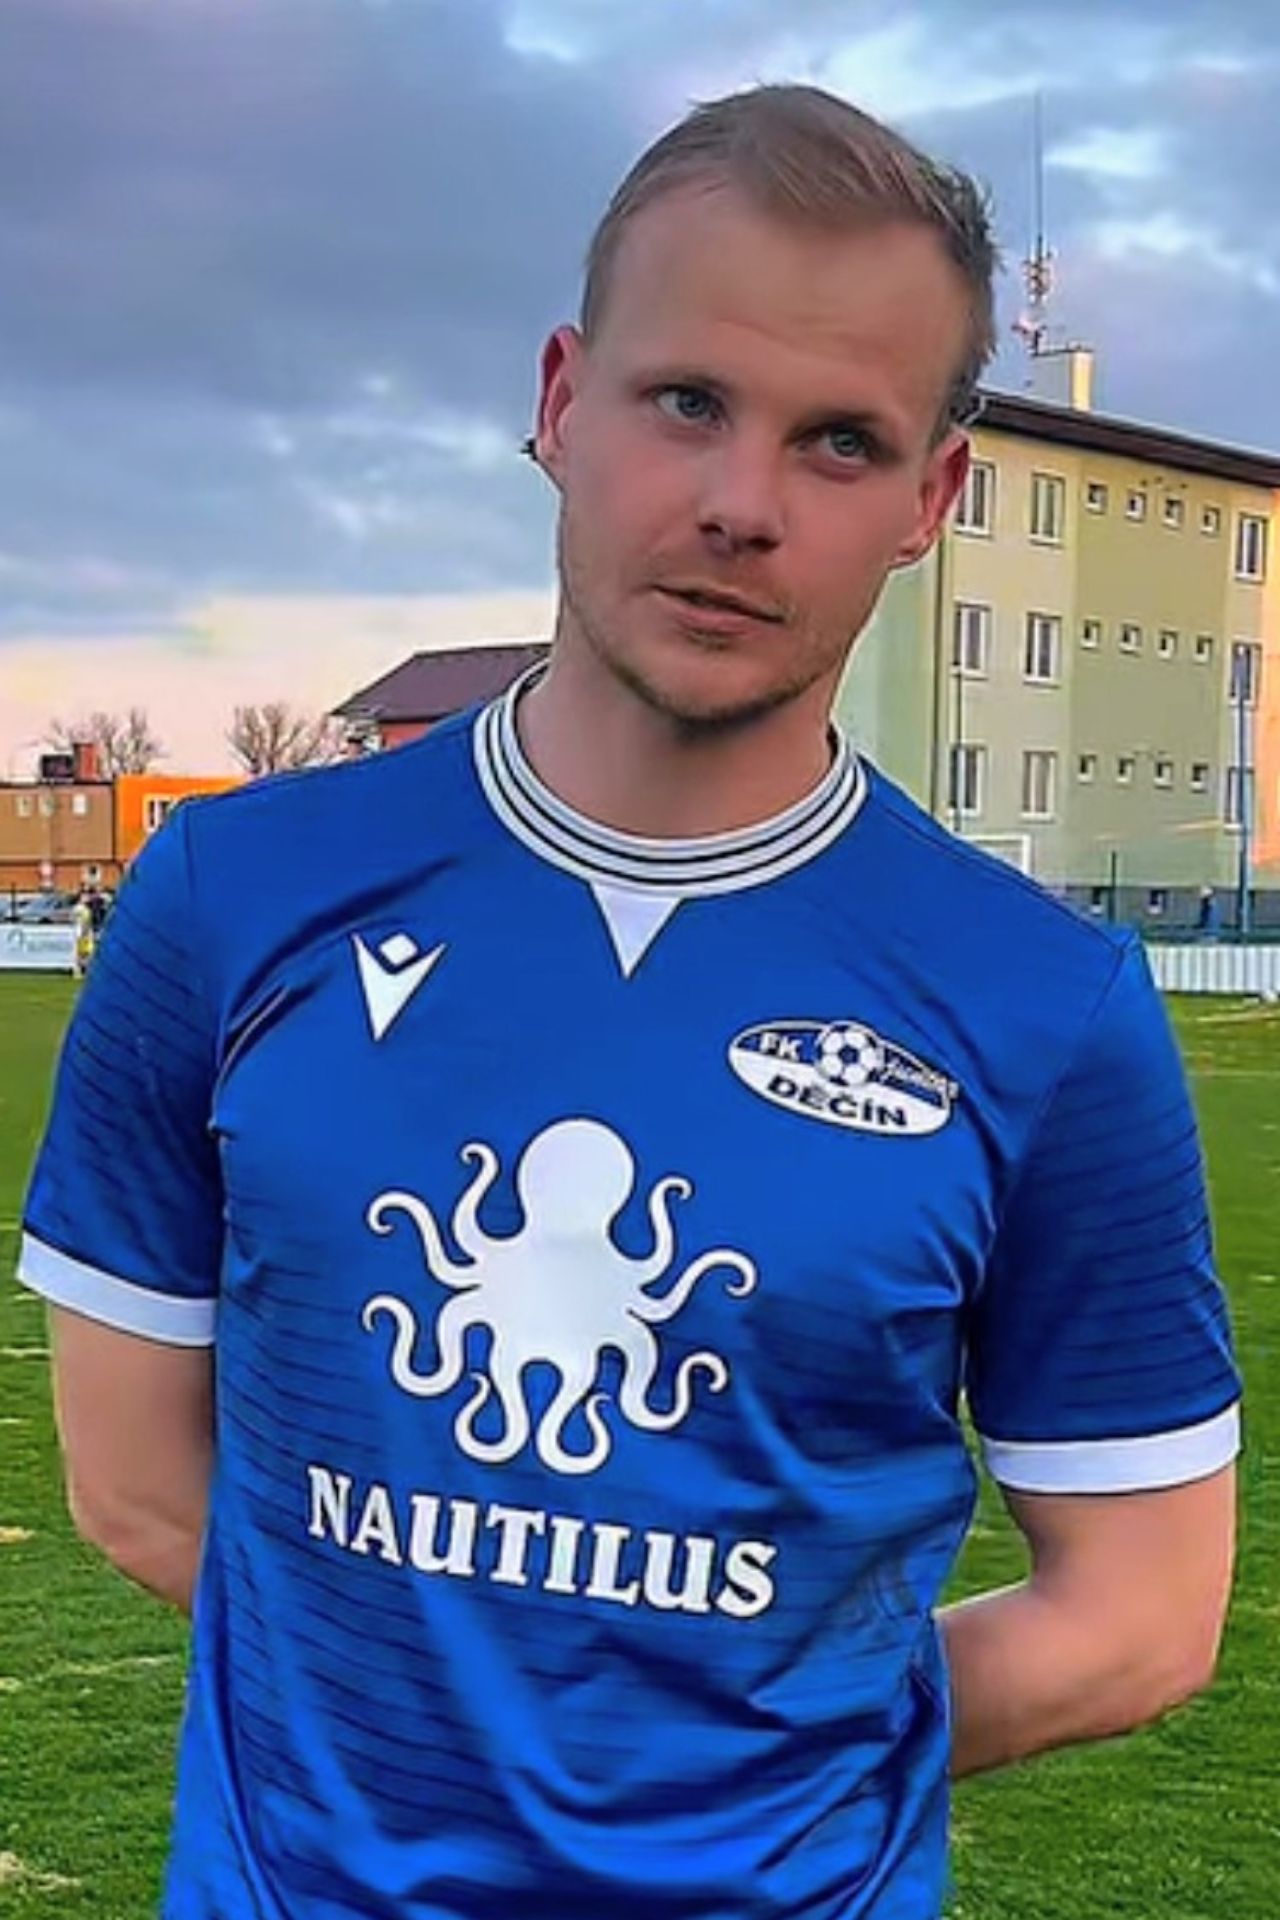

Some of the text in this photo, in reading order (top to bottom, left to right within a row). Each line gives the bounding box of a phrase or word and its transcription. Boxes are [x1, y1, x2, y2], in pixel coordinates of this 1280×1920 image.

[759, 1032, 802, 1063] FK
[767, 1075, 908, 1127] DĚČÍN
[307, 1465, 777, 1617] NAUTILUS
